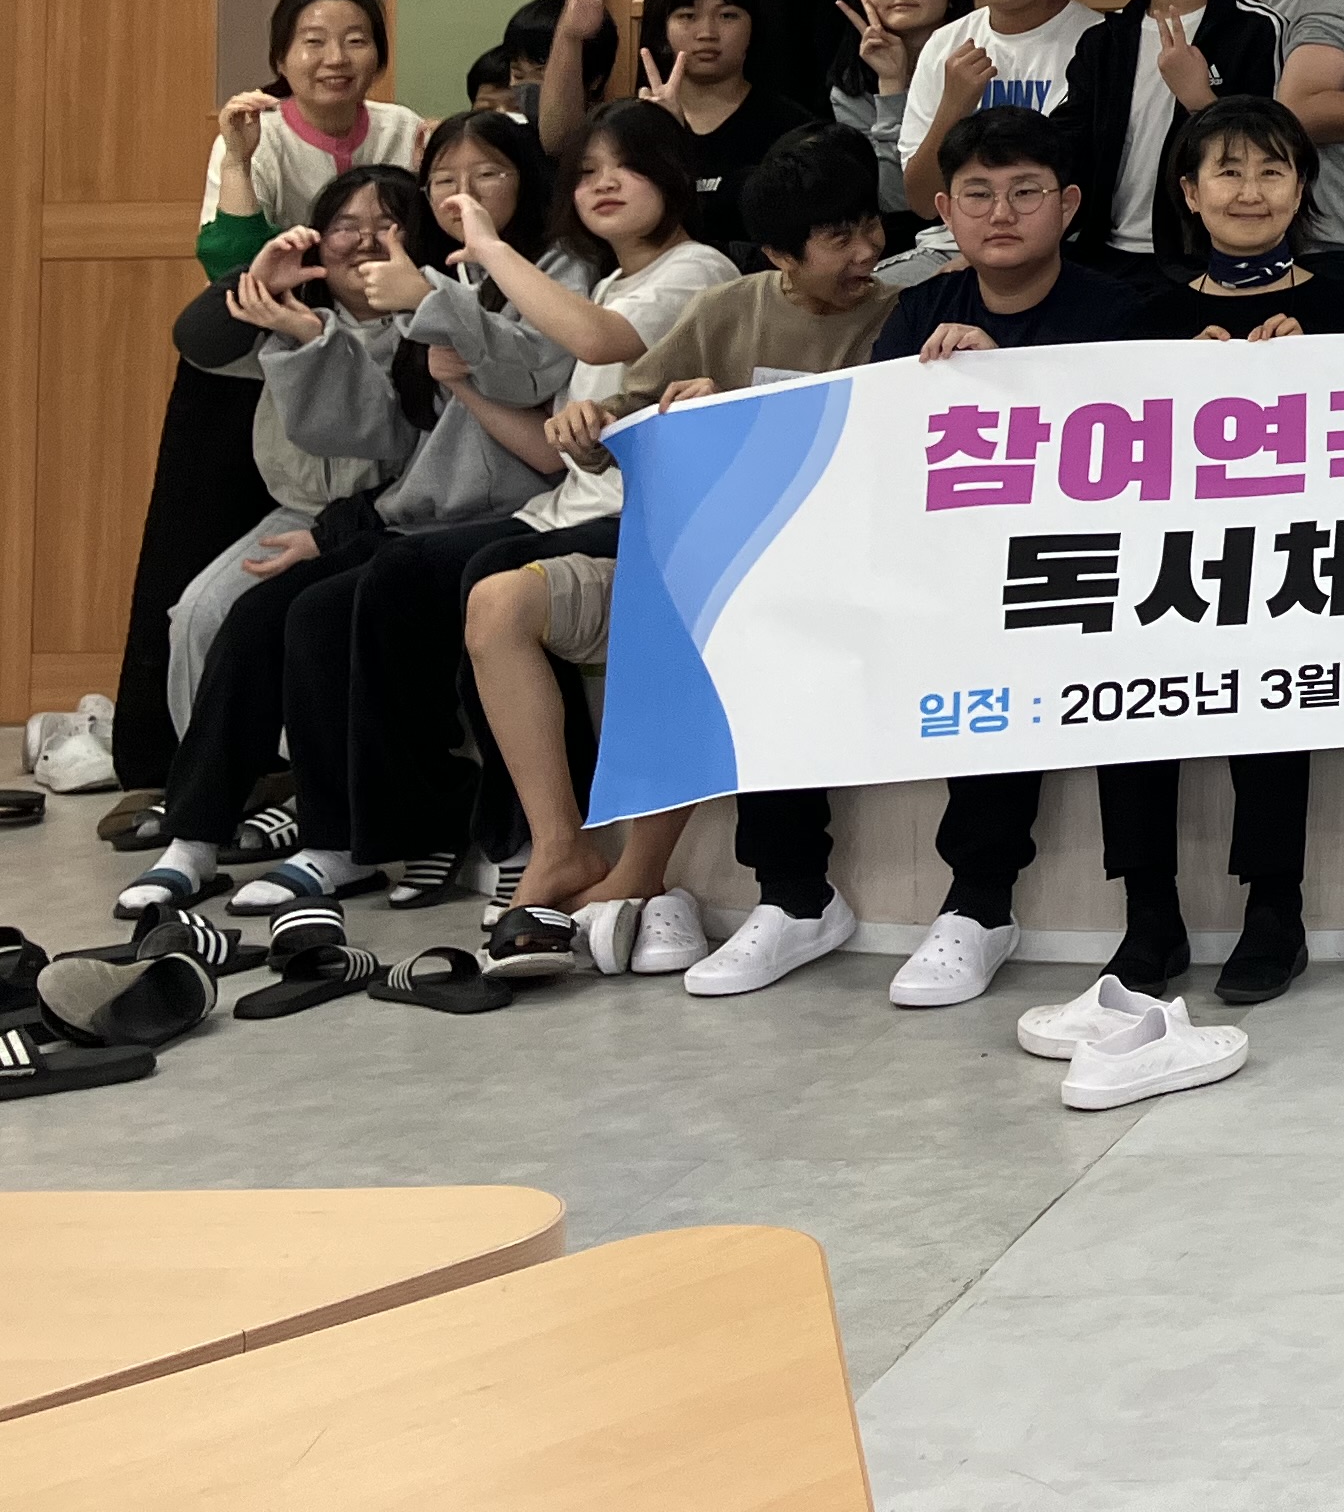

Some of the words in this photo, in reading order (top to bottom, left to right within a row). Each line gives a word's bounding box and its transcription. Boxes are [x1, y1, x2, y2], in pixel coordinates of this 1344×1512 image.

[919, 687, 1010, 738] 일정
[1061, 670, 1239, 726] 2025년
[1260, 662, 1341, 710] 3월
